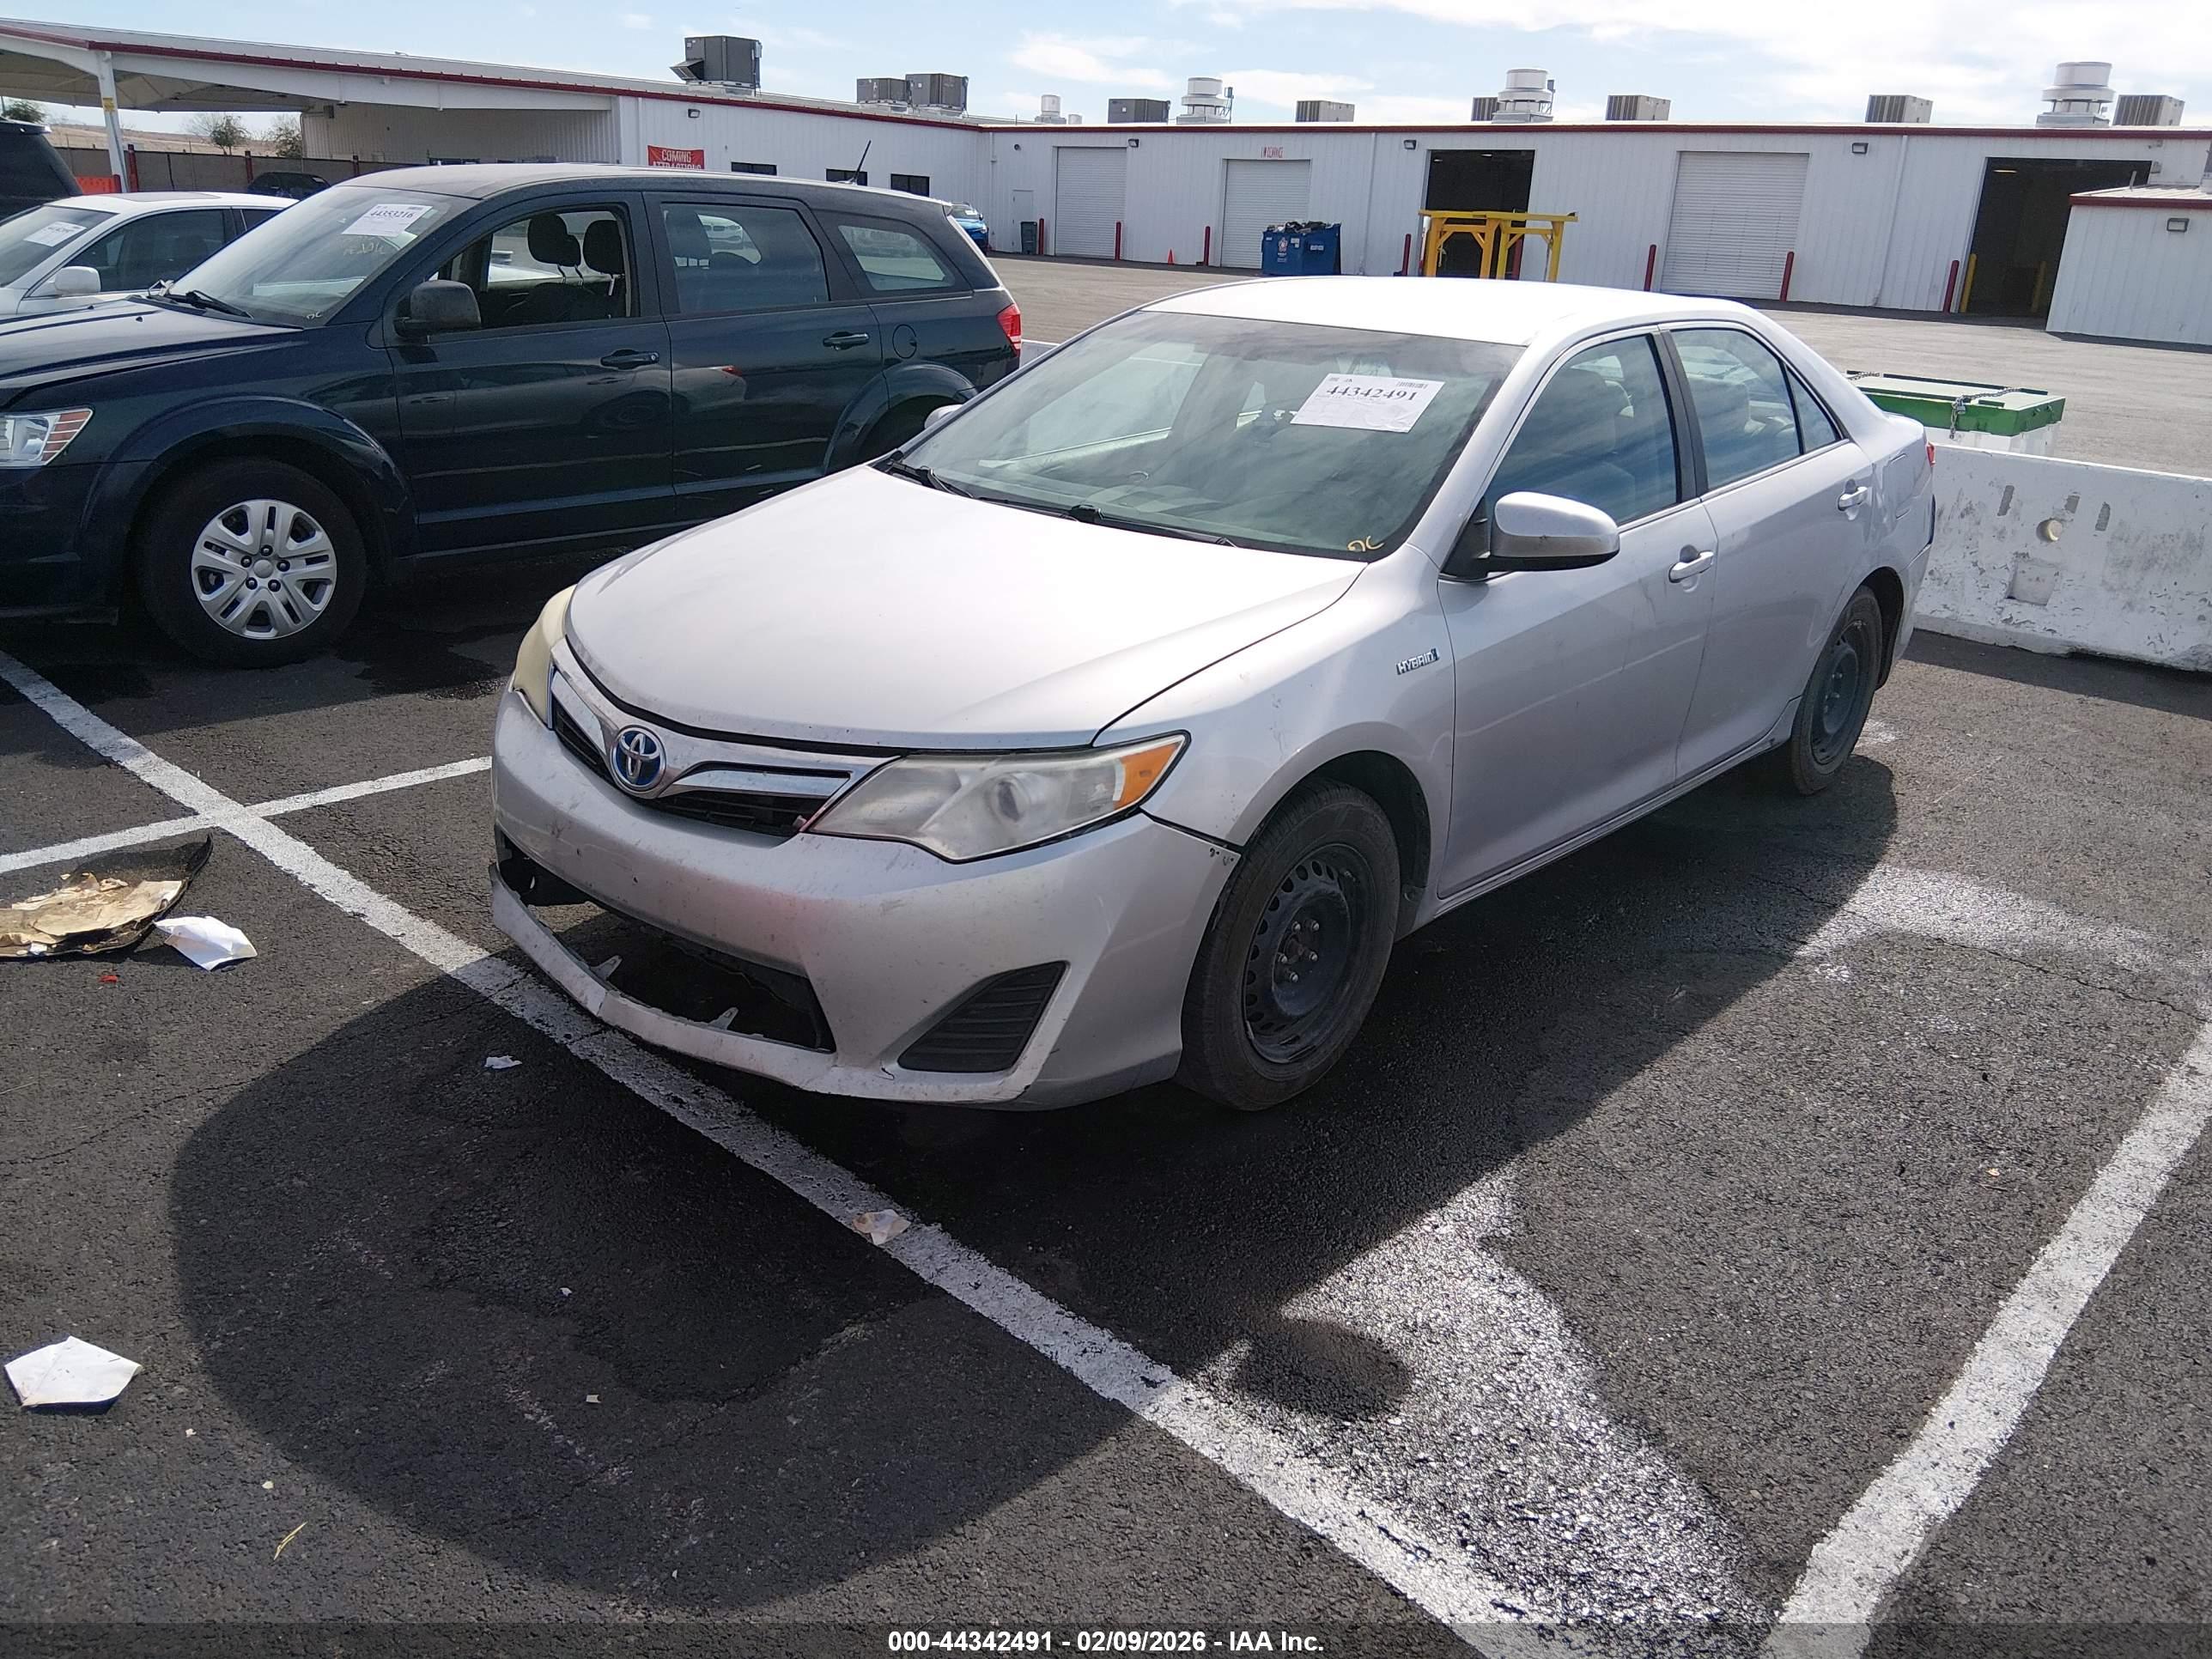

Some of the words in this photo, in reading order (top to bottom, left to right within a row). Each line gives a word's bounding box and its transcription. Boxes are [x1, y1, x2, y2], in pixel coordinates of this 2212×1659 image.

[661, 149, 692, 163] COMING
[1326, 385, 1419, 401] 44342491
[1396, 650, 1437, 675] HYBRID
